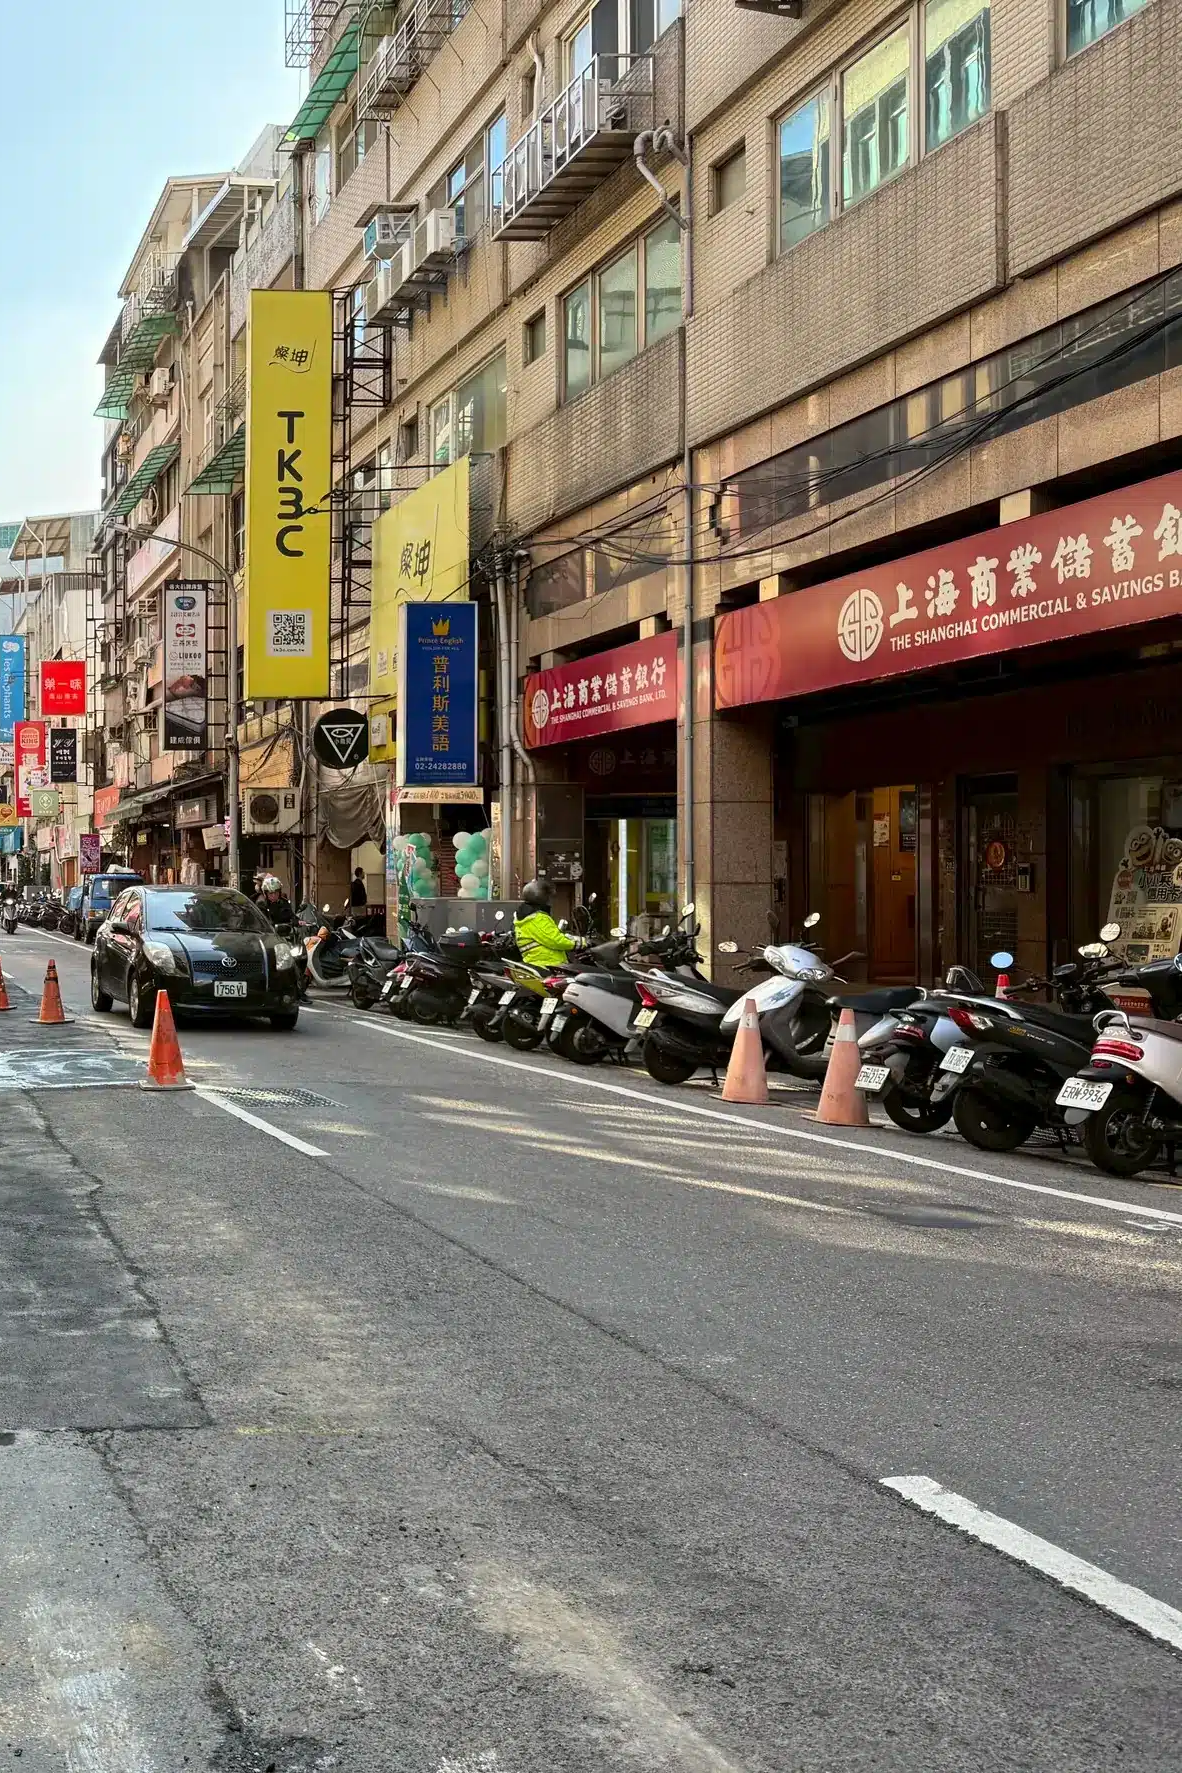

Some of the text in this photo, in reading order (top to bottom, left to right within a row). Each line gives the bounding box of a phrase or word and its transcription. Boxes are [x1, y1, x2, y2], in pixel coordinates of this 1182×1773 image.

[273, 345, 309, 367] 燦坤
[275, 411, 305, 557] TK3C
[399, 537, 430, 586] 燦坤
[890, 635, 912, 652] THE
[914, 618, 978, 648] SHANGHAI
[981, 596, 1072, 631] COMMERCIAL
[1076, 592, 1088, 609] &
[1091, 573, 1165, 607] SAVINGS
[431, 655, 450, 752] 普利斯美語
[550, 656, 667, 712] 上海商業儲蓄銀行
[559, 711, 581, 724] SHANGHAI
[582, 706, 612, 720] COMMERCIAL
[617, 697, 638, 710] SAVINGS
